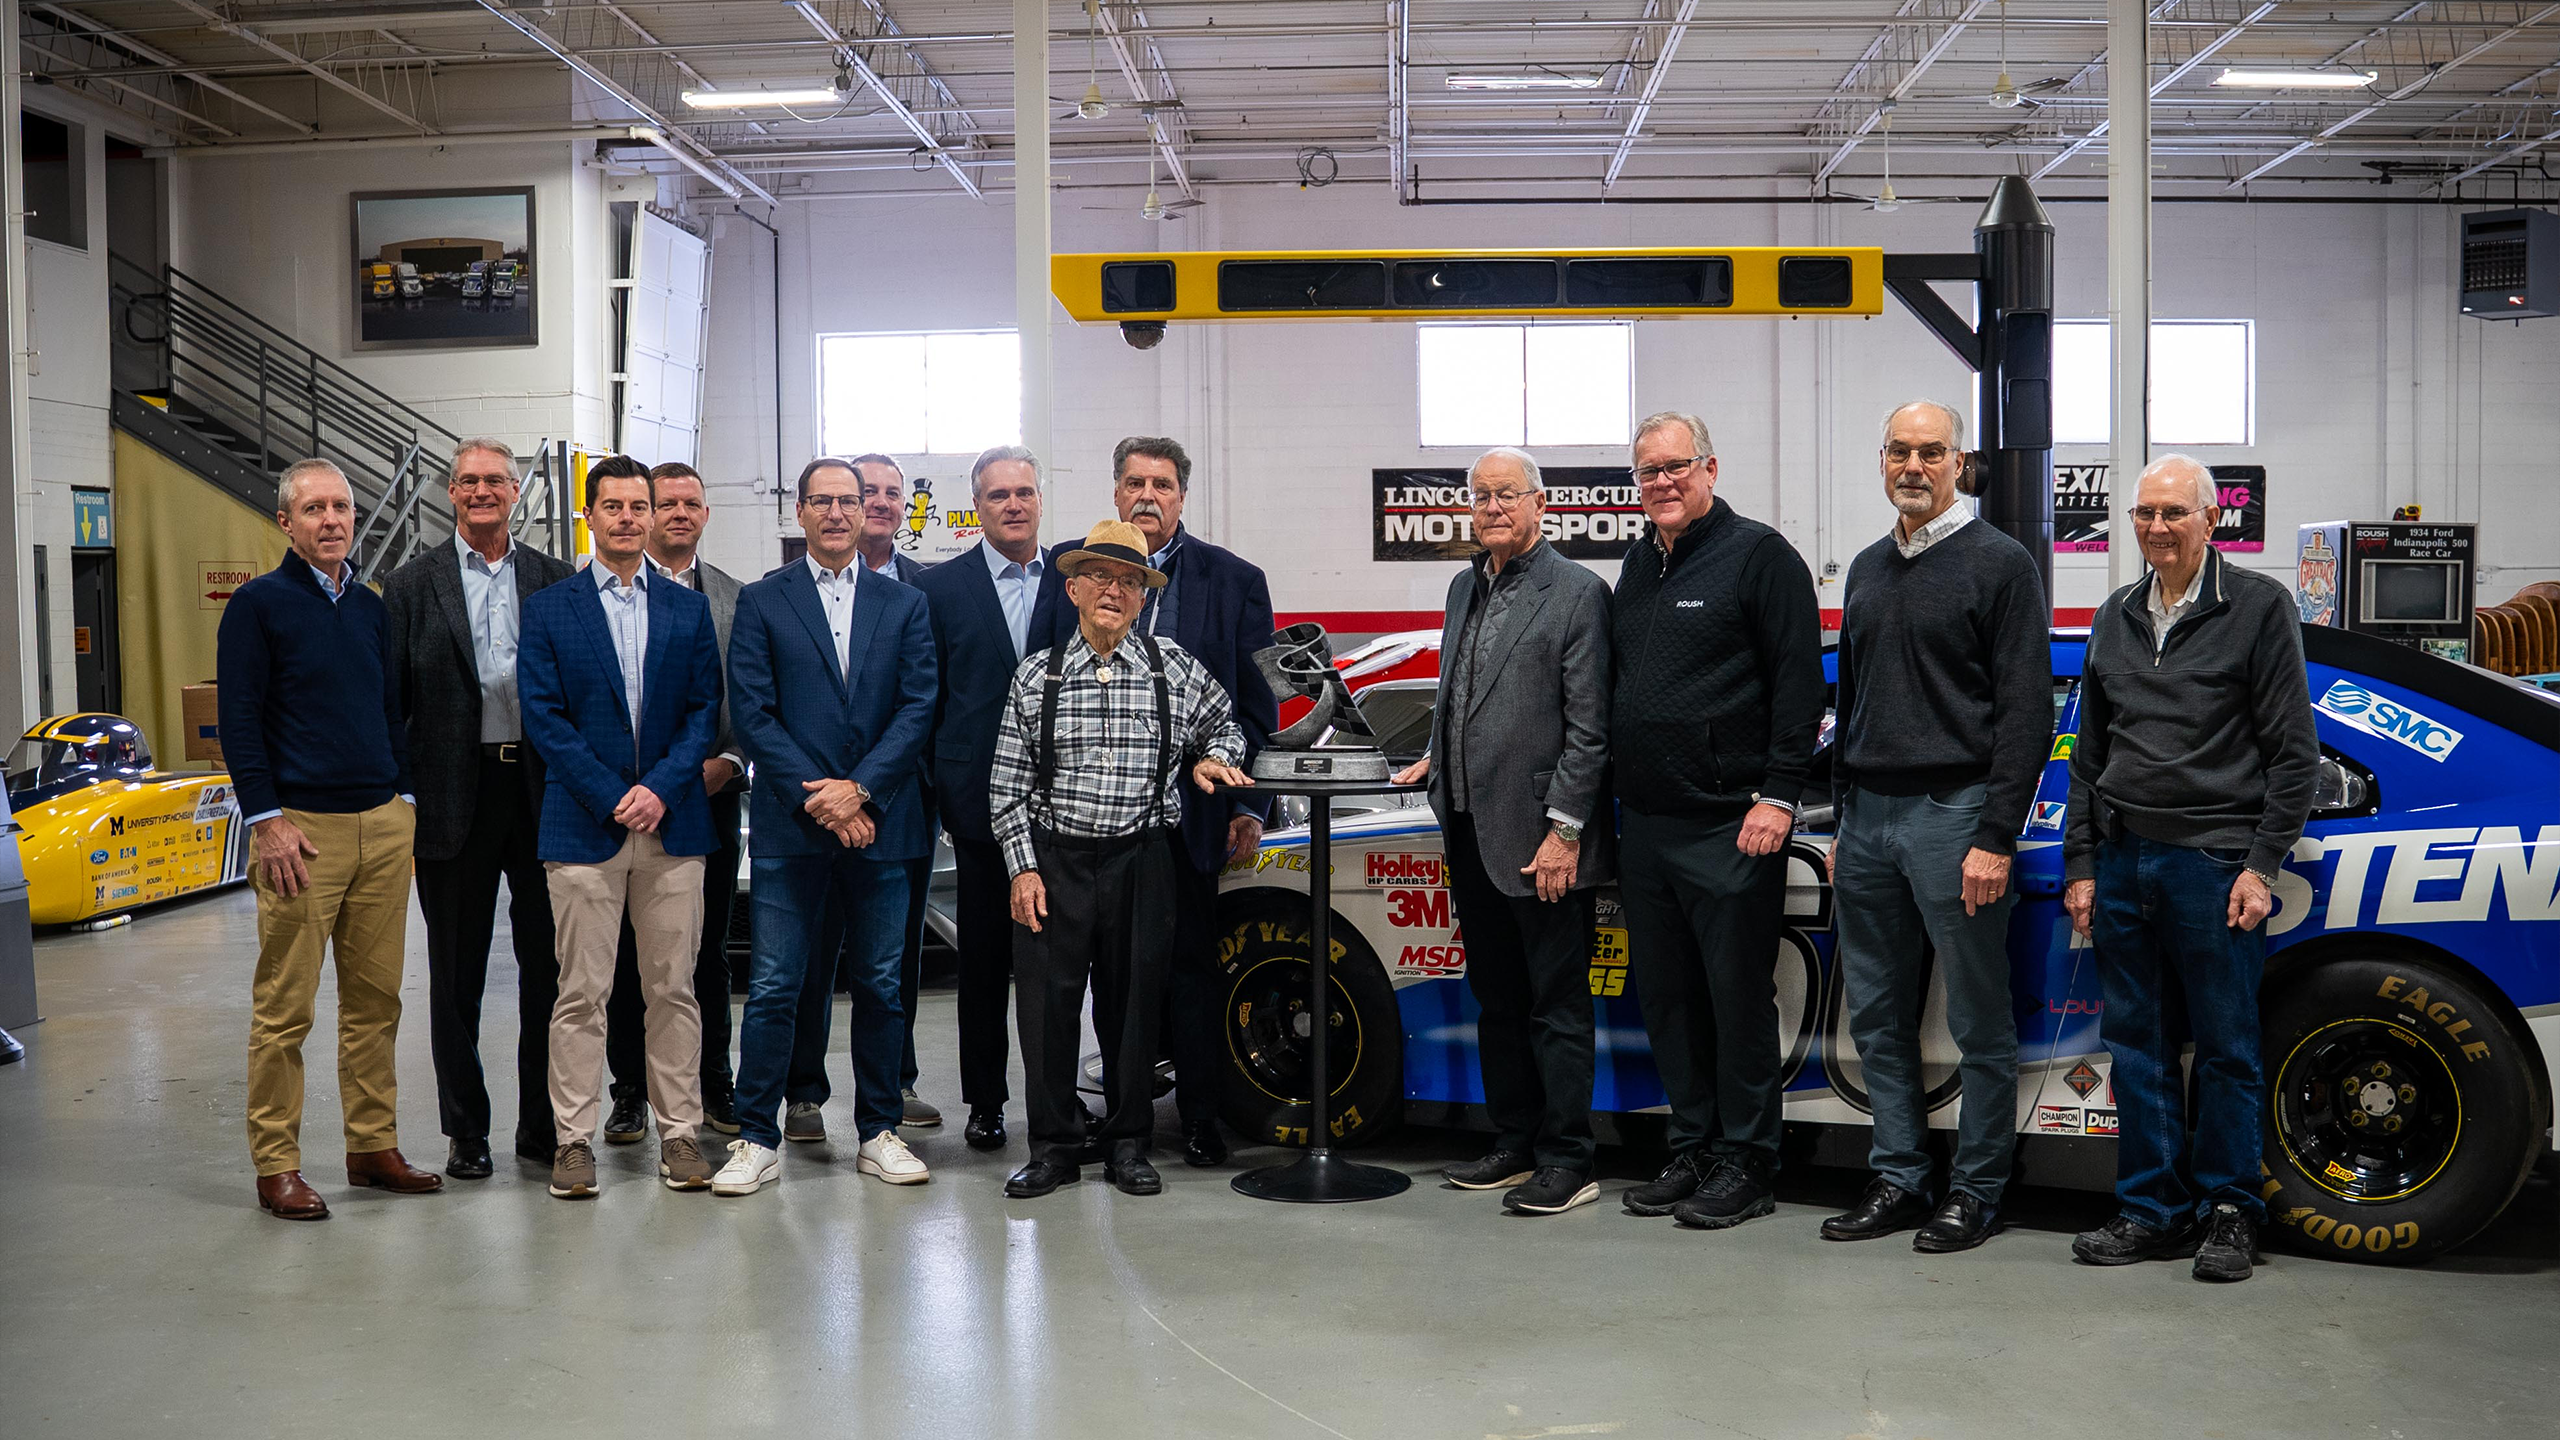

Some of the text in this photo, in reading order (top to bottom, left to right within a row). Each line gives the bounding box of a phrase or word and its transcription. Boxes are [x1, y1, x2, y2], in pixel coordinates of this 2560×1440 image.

[75, 493, 105, 505] Restroom
[1384, 486, 1642, 506] LINCO ERCUR
[2055, 496, 2109, 507] ATTER
[947, 511, 982, 528] PLAN
[954, 527, 985, 540] Rac
[2356, 530, 2389, 538] ROUSH
[2409, 528, 2454, 537] 1934 Ford
[935, 546, 962, 554] Everybody
[2075, 543, 2109, 553] WELC
[2394, 538, 2468, 549] Indianapolis 500
[2409, 549, 2452, 557] Race Car
[206, 571, 251, 585] RESTROOM
[1676, 600, 1704, 608] ROUSH
[2368, 702, 2452, 753] SMC
[109, 811, 194, 836] M UNIVERSITY OF MICHIGAN
[91, 868, 131, 882] BANK OF AMERICA
[1367, 854, 1440, 885] Holley
[1368, 877, 1428, 885] HP CARBS
[2267, 824, 2560, 937] STEN
[112, 884, 139, 900] SIEMENS
[1387, 890, 1450, 928] 3M
[1595, 904, 1621, 914] GHT
[1397, 945, 1466, 967] MSD
[2376, 975, 2491, 1062] EAGLE
[2041, 1111, 2078, 1122] CHAMPION
[2087, 1112, 2119, 1130] Dup
[1275, 1105, 1363, 1144] EALE
